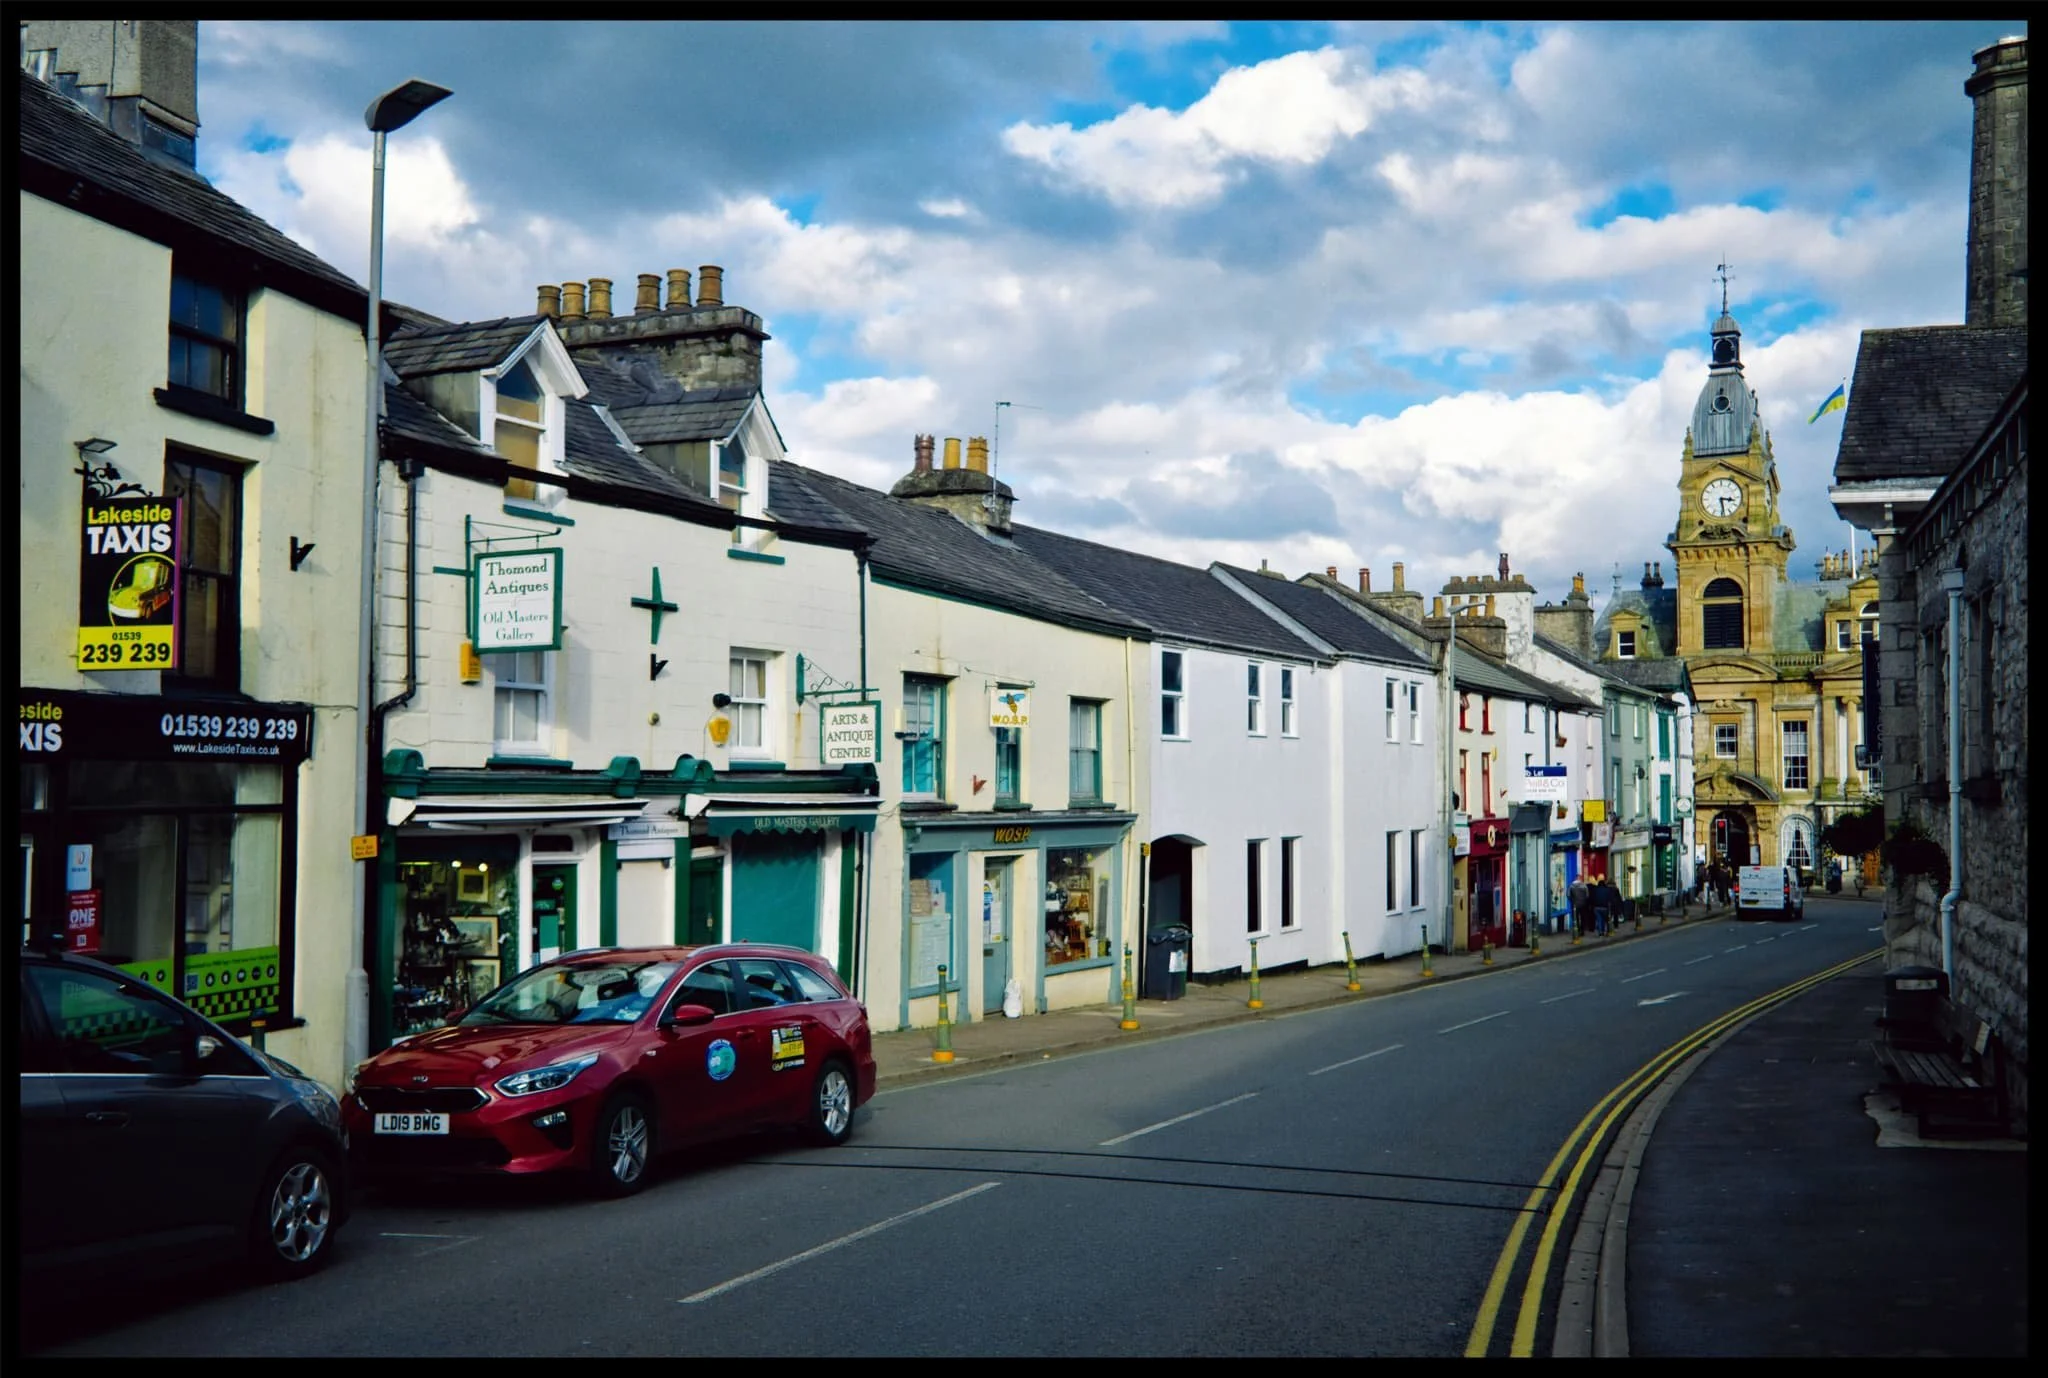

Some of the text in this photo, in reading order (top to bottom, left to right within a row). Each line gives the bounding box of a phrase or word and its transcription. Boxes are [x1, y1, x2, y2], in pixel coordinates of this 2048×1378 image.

[87, 505, 172, 524] Lakeside
[87, 524, 172, 554] TAXIS
[486, 558, 547, 576] Thomond
[484, 580, 549, 595] Antiques
[484, 610, 548, 624] Old Masters
[112, 632, 141, 641] 01539
[496, 627, 534, 641] Gallery
[82, 643, 171, 663] 239 239
[161, 713, 298, 740] 01539 239 239
[831, 714, 869, 725] ARTS &
[827, 730, 873, 743] ANTIQUE
[173, 742, 280, 755] www.LakesideTaxis.co.uk
[830, 747, 871, 758] CENTRE
[382, 1115, 441, 1130] LD19 BWG
